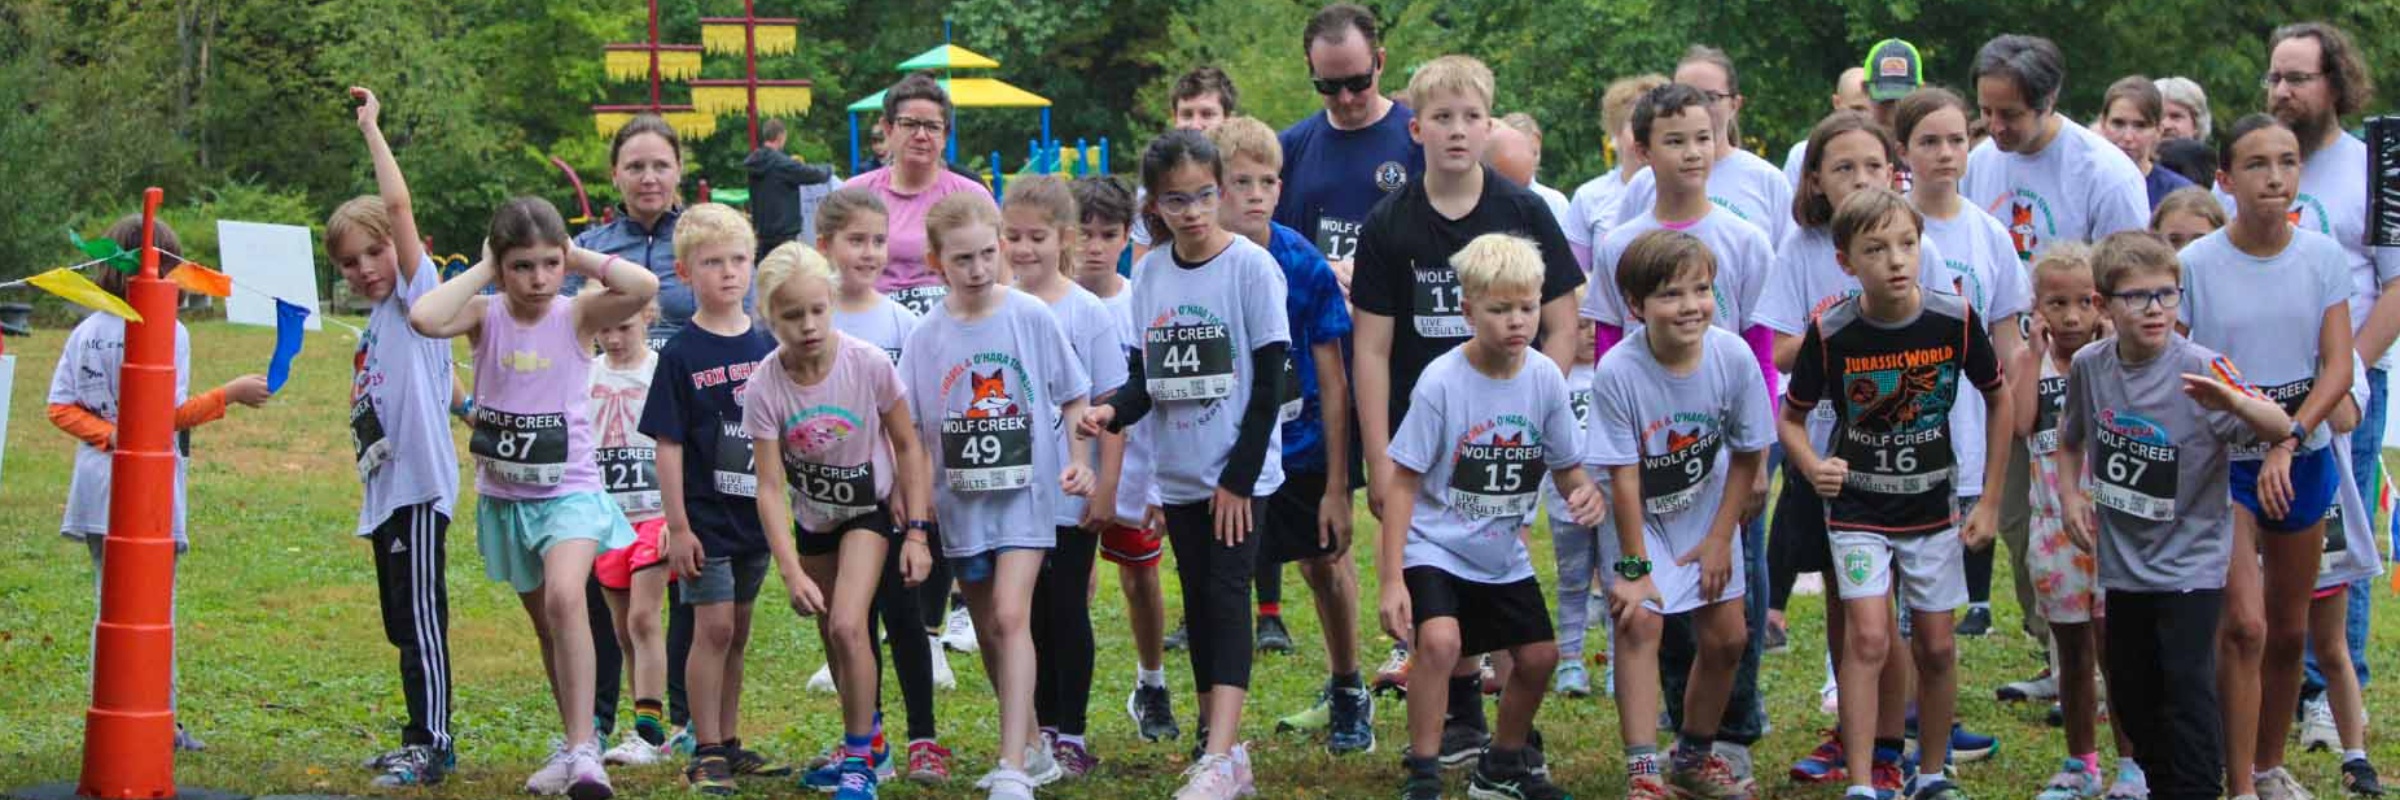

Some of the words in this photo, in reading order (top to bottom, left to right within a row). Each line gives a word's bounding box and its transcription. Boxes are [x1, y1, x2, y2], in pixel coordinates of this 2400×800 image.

[1320, 219, 1354, 233] WOLF
[1415, 270, 1455, 284] WOLF
[890, 289, 909, 301] OLF
[911, 285, 947, 298] CREEK
[1147, 329, 1175, 343] WOLF
[1178, 325, 1226, 341] CREEK
[1163, 344, 1200, 373] 44
[1844, 353, 1905, 374] JURASSIC
[1904, 346, 1953, 368] WORLD
[692, 366, 727, 391] FOX
[2040, 379, 2066, 395] OLF
[2267, 380, 2310, 401] CREEK
[479, 410, 512, 428] WOLF
[515, 414, 563, 429] CREEK
[942, 420, 975, 434] WOLF
[977, 416, 1026, 432] CREEK
[497, 431, 537, 460] 87
[1847, 427, 1891, 447] WOLF
[1894, 427, 1943, 446] CREEK
[595, 449, 616, 462] OLF
[961, 434, 1002, 465] 49
[1462, 444, 1503, 460] WOLF
[1645, 449, 1687, 469] WOLF
[1874, 447, 1917, 472] 16
[2129, 441, 2176, 462] CREEK
[599, 461, 649, 489] 121
[821, 464, 869, 480] CREEK
[1483, 463, 1523, 491] 15
[1685, 457, 1704, 483] 9
[2107, 452, 2148, 486] 67
[797, 472, 855, 503] 120
[1456, 492, 1482, 503] LIVE
[1456, 500, 1503, 516] RESULTS
